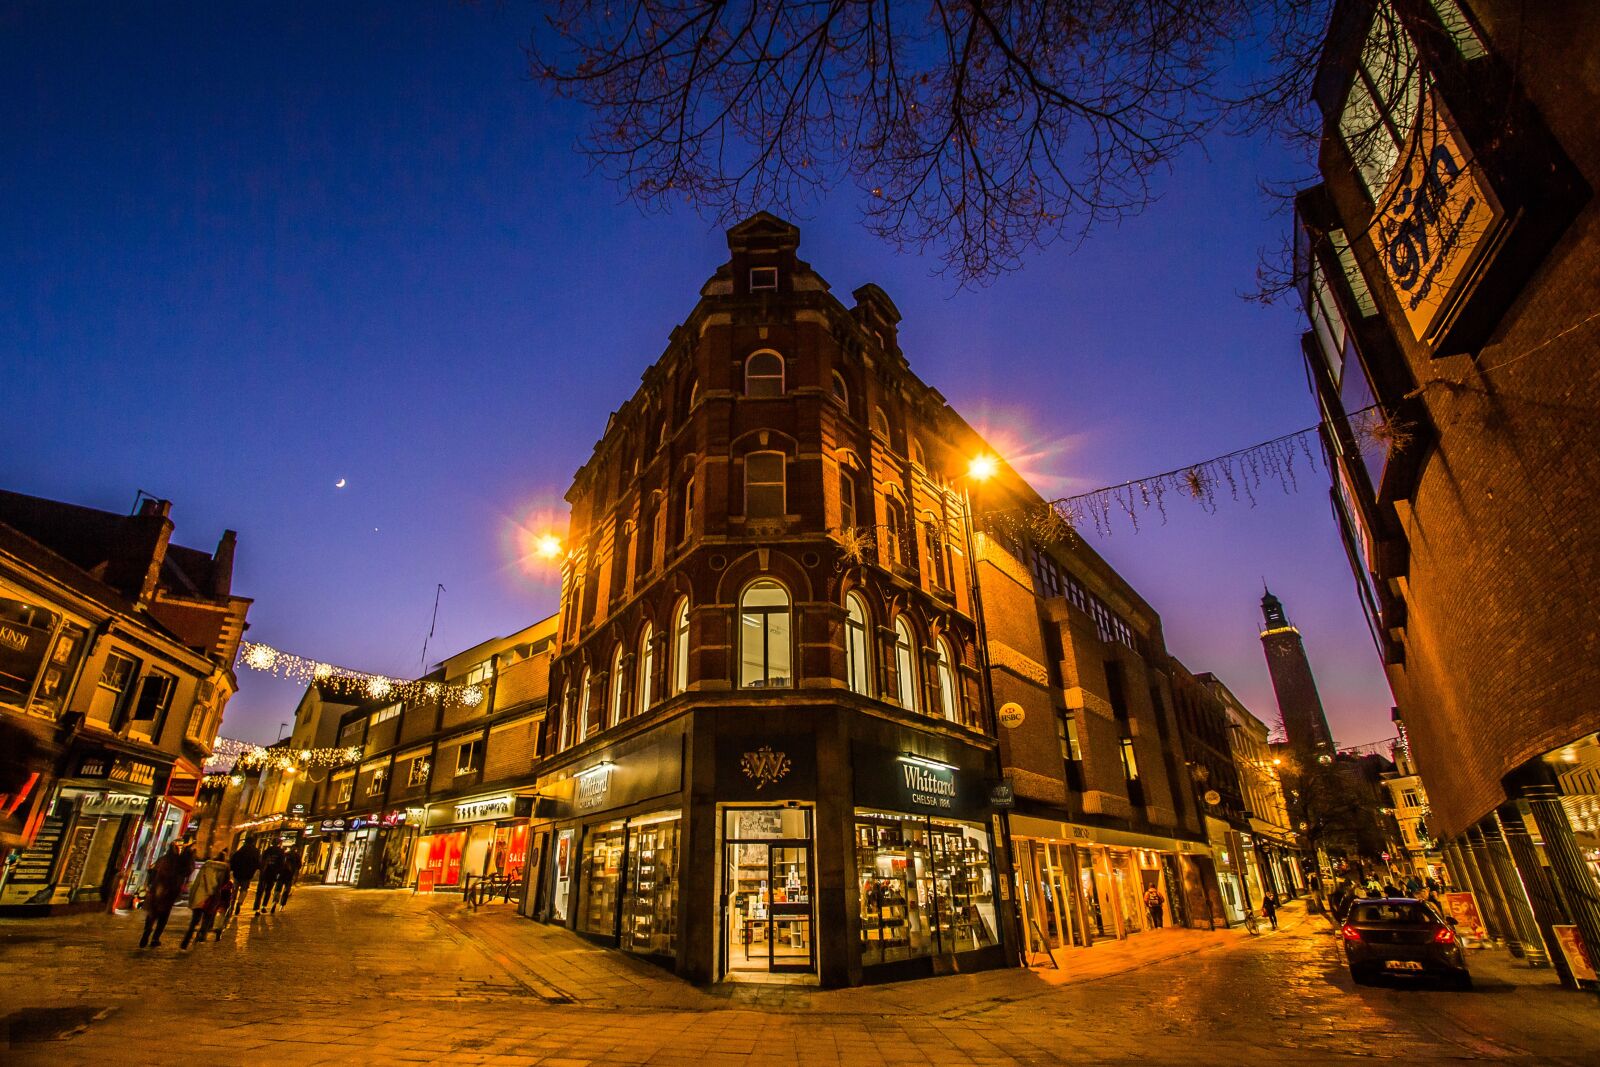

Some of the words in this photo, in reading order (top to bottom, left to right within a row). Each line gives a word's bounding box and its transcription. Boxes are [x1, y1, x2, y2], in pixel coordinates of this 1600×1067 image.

[1001, 713, 1022, 722] HSBC
[81, 765, 104, 775] HILL
[129, 762, 156, 785] HILL
[903, 764, 956, 797] Whittard
[912, 793, 938, 806] CHELSEA
[428, 858, 443, 868] SALE
[508, 852, 526, 863] SALE
